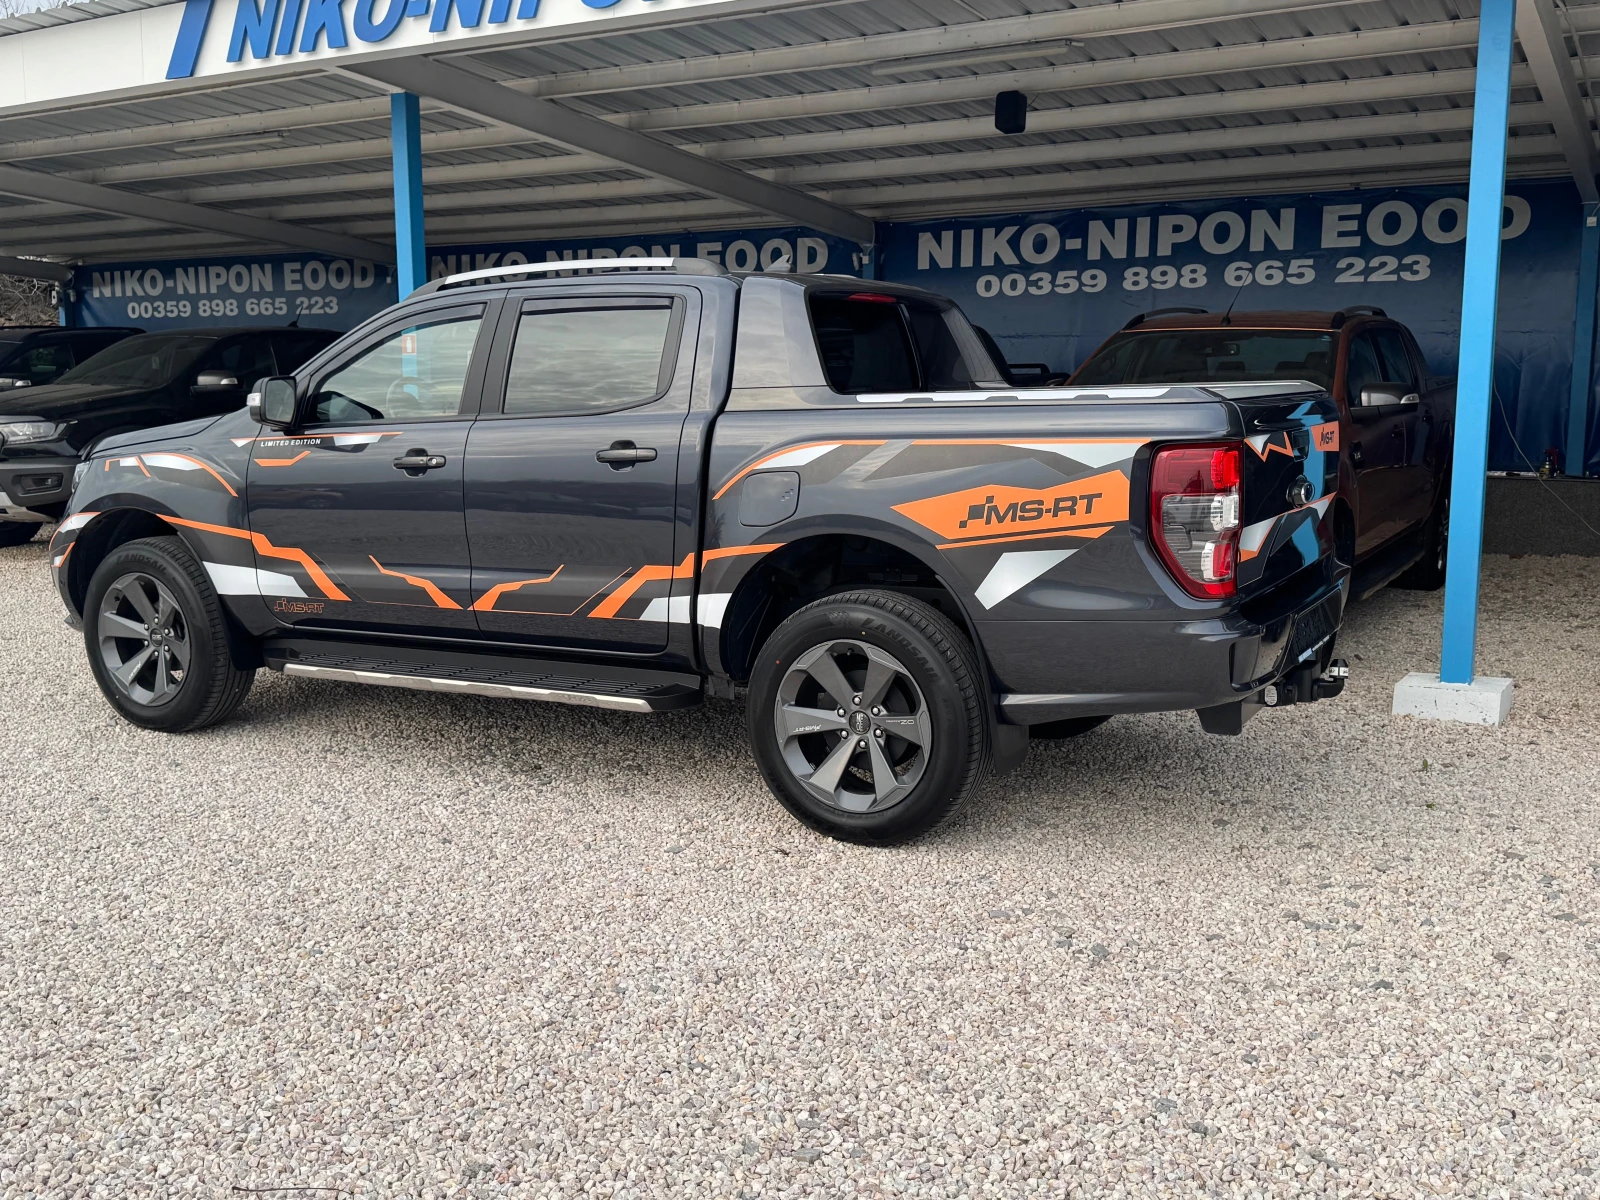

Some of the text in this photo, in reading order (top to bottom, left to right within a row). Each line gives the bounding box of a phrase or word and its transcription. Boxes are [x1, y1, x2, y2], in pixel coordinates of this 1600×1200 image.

[918, 207, 1296, 270] NIKO-NIPON
[92, 259, 375, 298] NIKO-NIPON EOOD
[976, 254, 1431, 298] 00359 898 665 223
[127, 296, 339, 319] 00359 898 665 223
[260, 438, 322, 448] LIMITED EDITION
